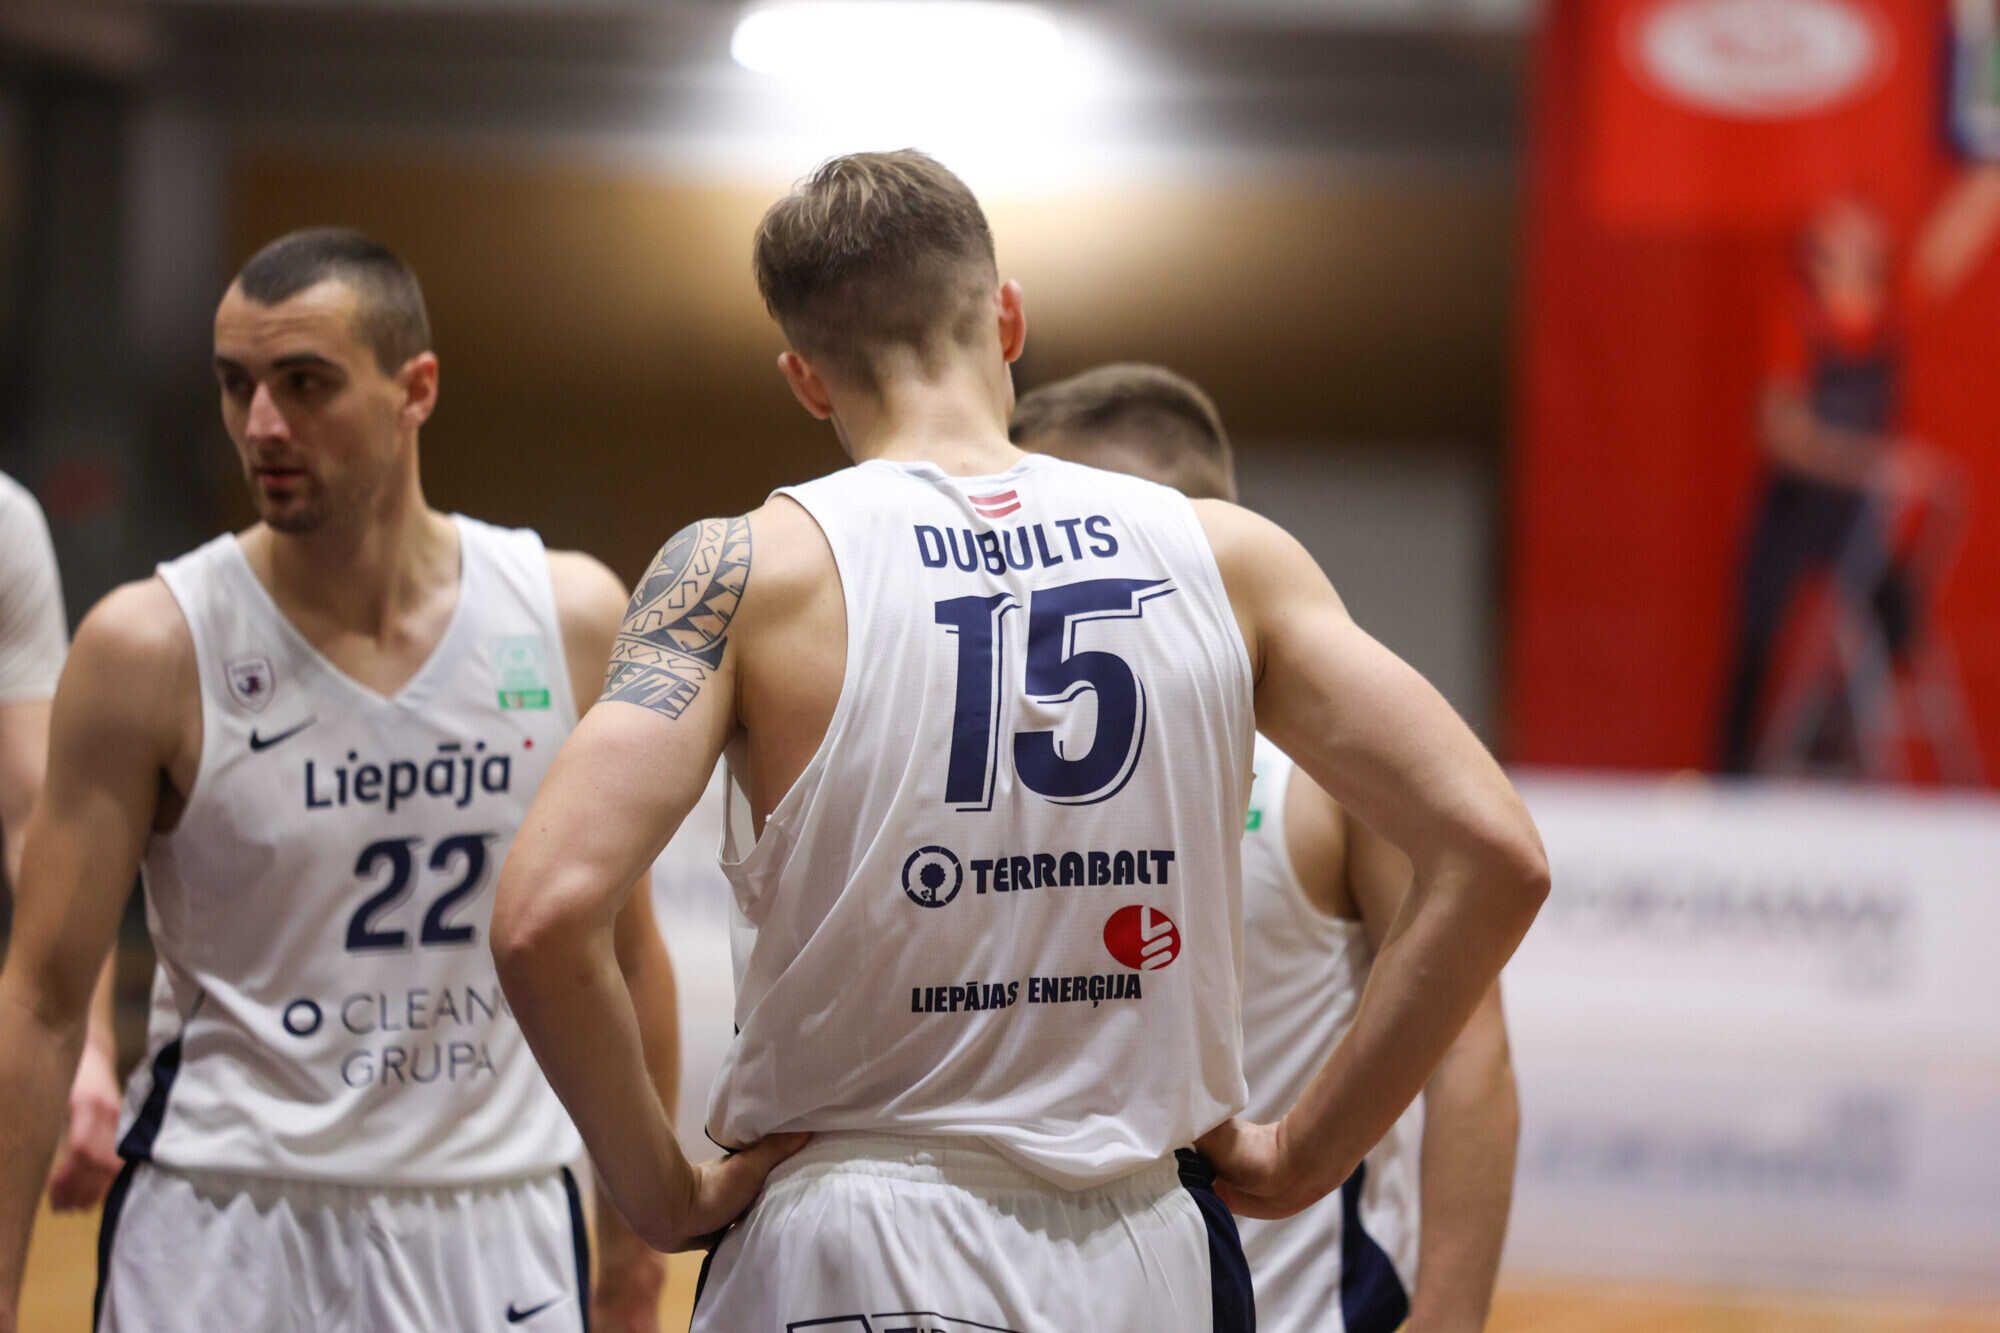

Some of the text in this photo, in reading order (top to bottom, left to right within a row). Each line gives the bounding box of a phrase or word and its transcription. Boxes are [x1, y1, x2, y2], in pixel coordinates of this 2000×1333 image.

[914, 515, 1119, 576] DUBULTS
[935, 578, 1177, 812] 15
[305, 741, 511, 813] Liepāja
[344, 832, 499, 953] 22
[970, 850, 1175, 894] TERRABALT
[340, 985, 512, 1035] CLEAN
[911, 973, 1142, 1013] LIEPĀJAS ENERĢIJA
[340, 1041, 497, 1088] GRUPA
